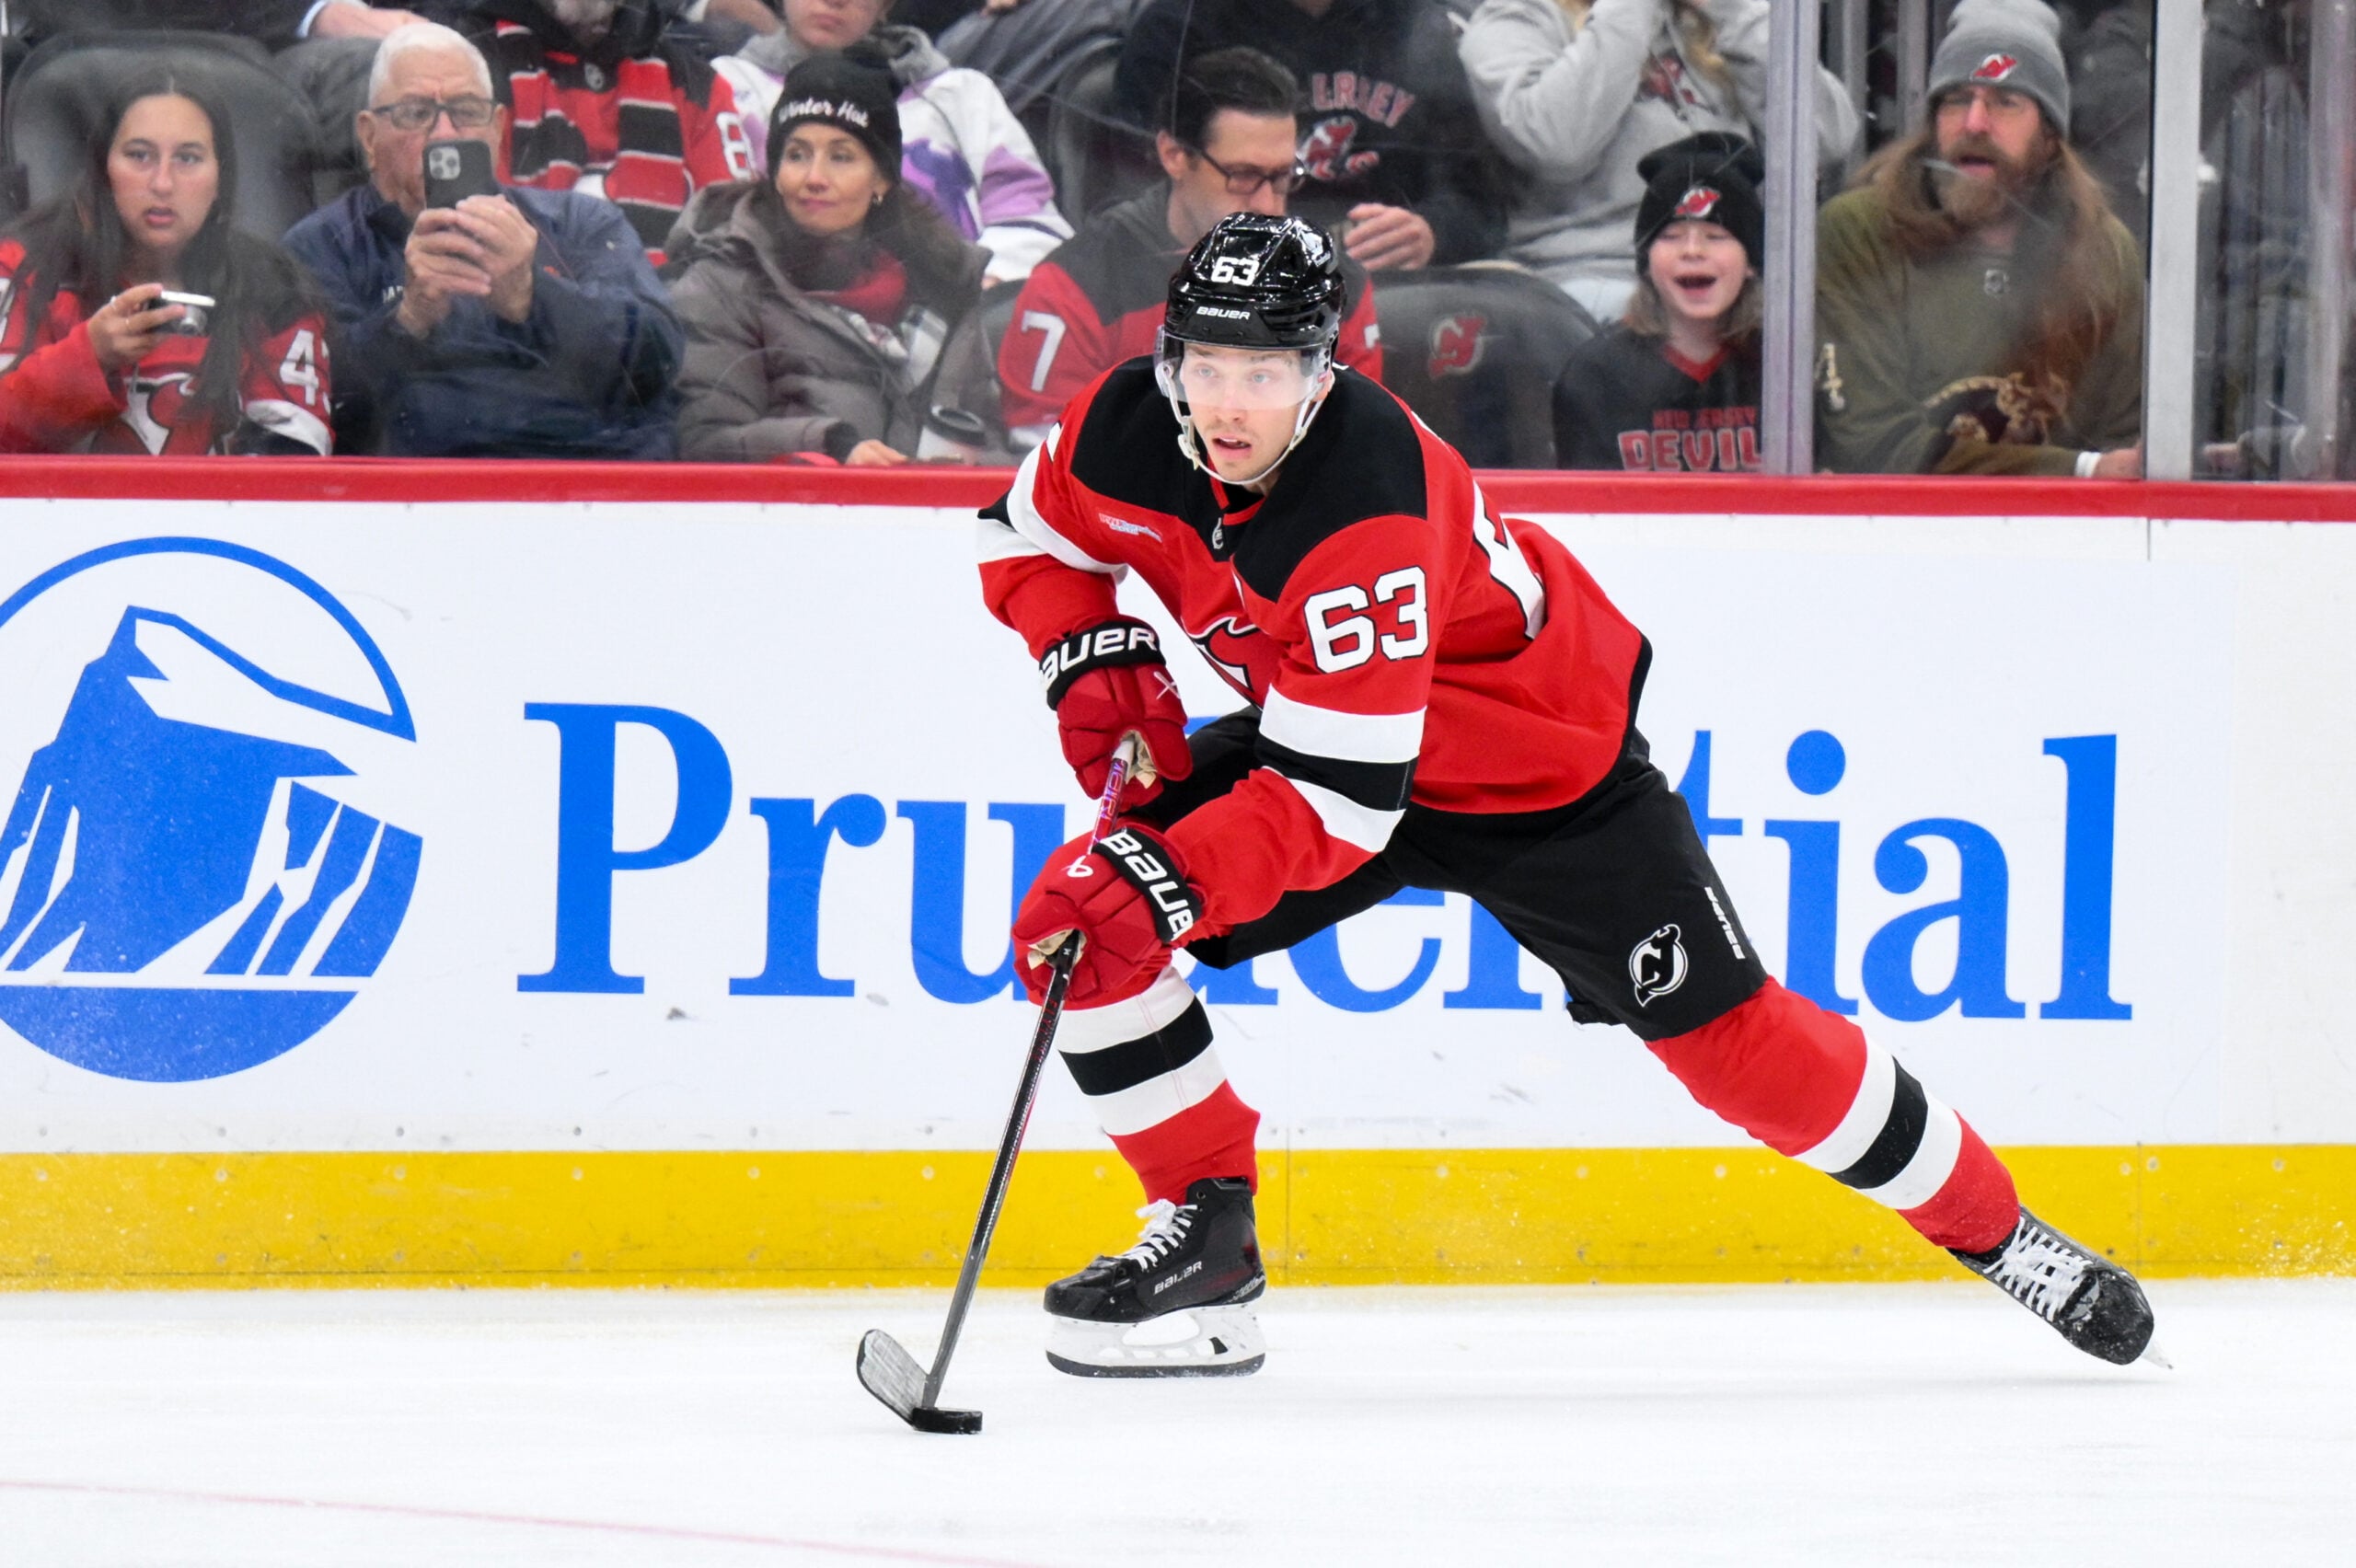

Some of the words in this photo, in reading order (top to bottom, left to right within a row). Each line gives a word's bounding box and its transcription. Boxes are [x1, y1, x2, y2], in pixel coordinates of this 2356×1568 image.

[778, 96, 833, 125] Winter
[1210, 256, 1260, 286] 63
[1196, 306, 1251, 320] BAUER
[1022, 309, 1066, 393] 7
[1303, 565, 1429, 674] 63
[1039, 627, 1158, 691] AUER
[516, 701, 2132, 1022] Pruial
[1100, 827, 1194, 941] BAUE
[1154, 1260, 1203, 1296] BAUER
